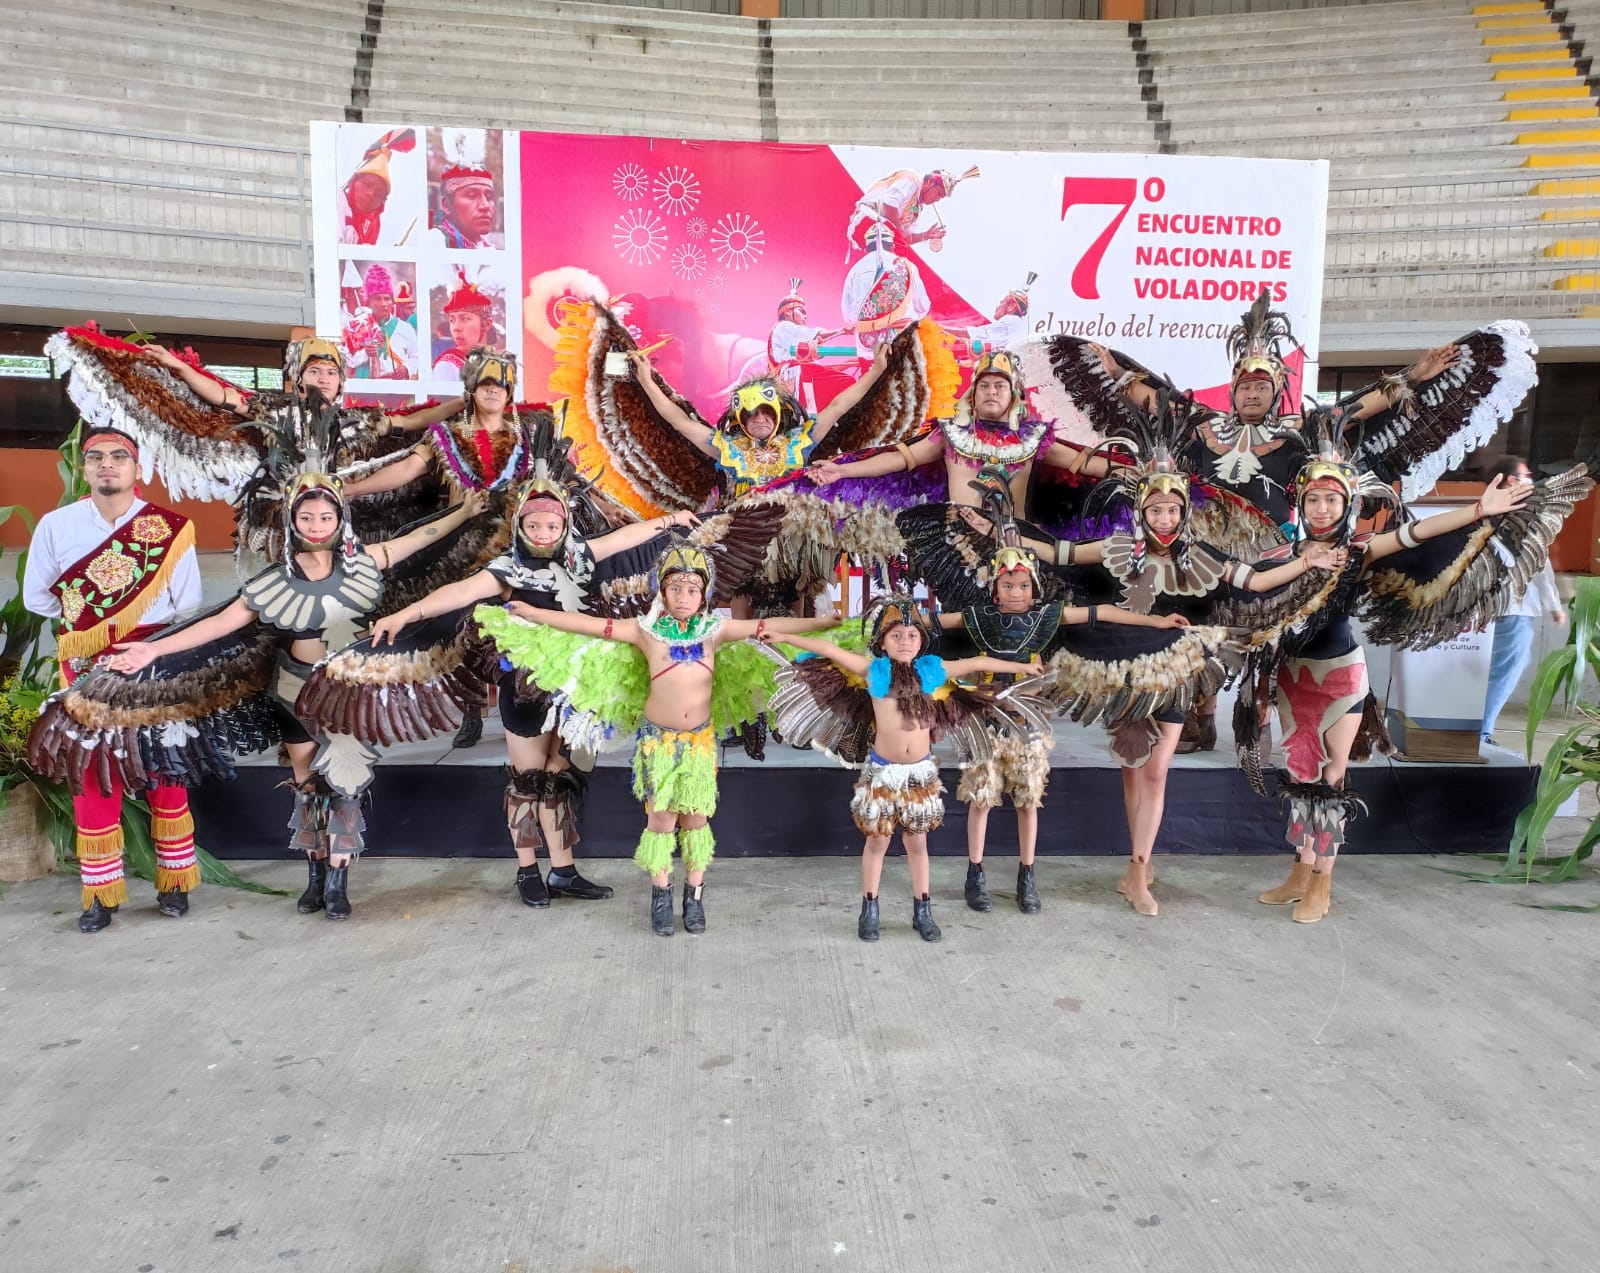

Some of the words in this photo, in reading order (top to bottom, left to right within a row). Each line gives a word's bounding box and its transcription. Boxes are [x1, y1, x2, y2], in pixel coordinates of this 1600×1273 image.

[1137, 213, 1281, 237] ENCUENTRO
[1135, 246, 1256, 269] NACIONAL
[1261, 249, 1292, 269] DE
[1034, 312, 1054, 333] el
[1058, 313, 1116, 337] vuelo
[1121, 313, 1154, 338] del
